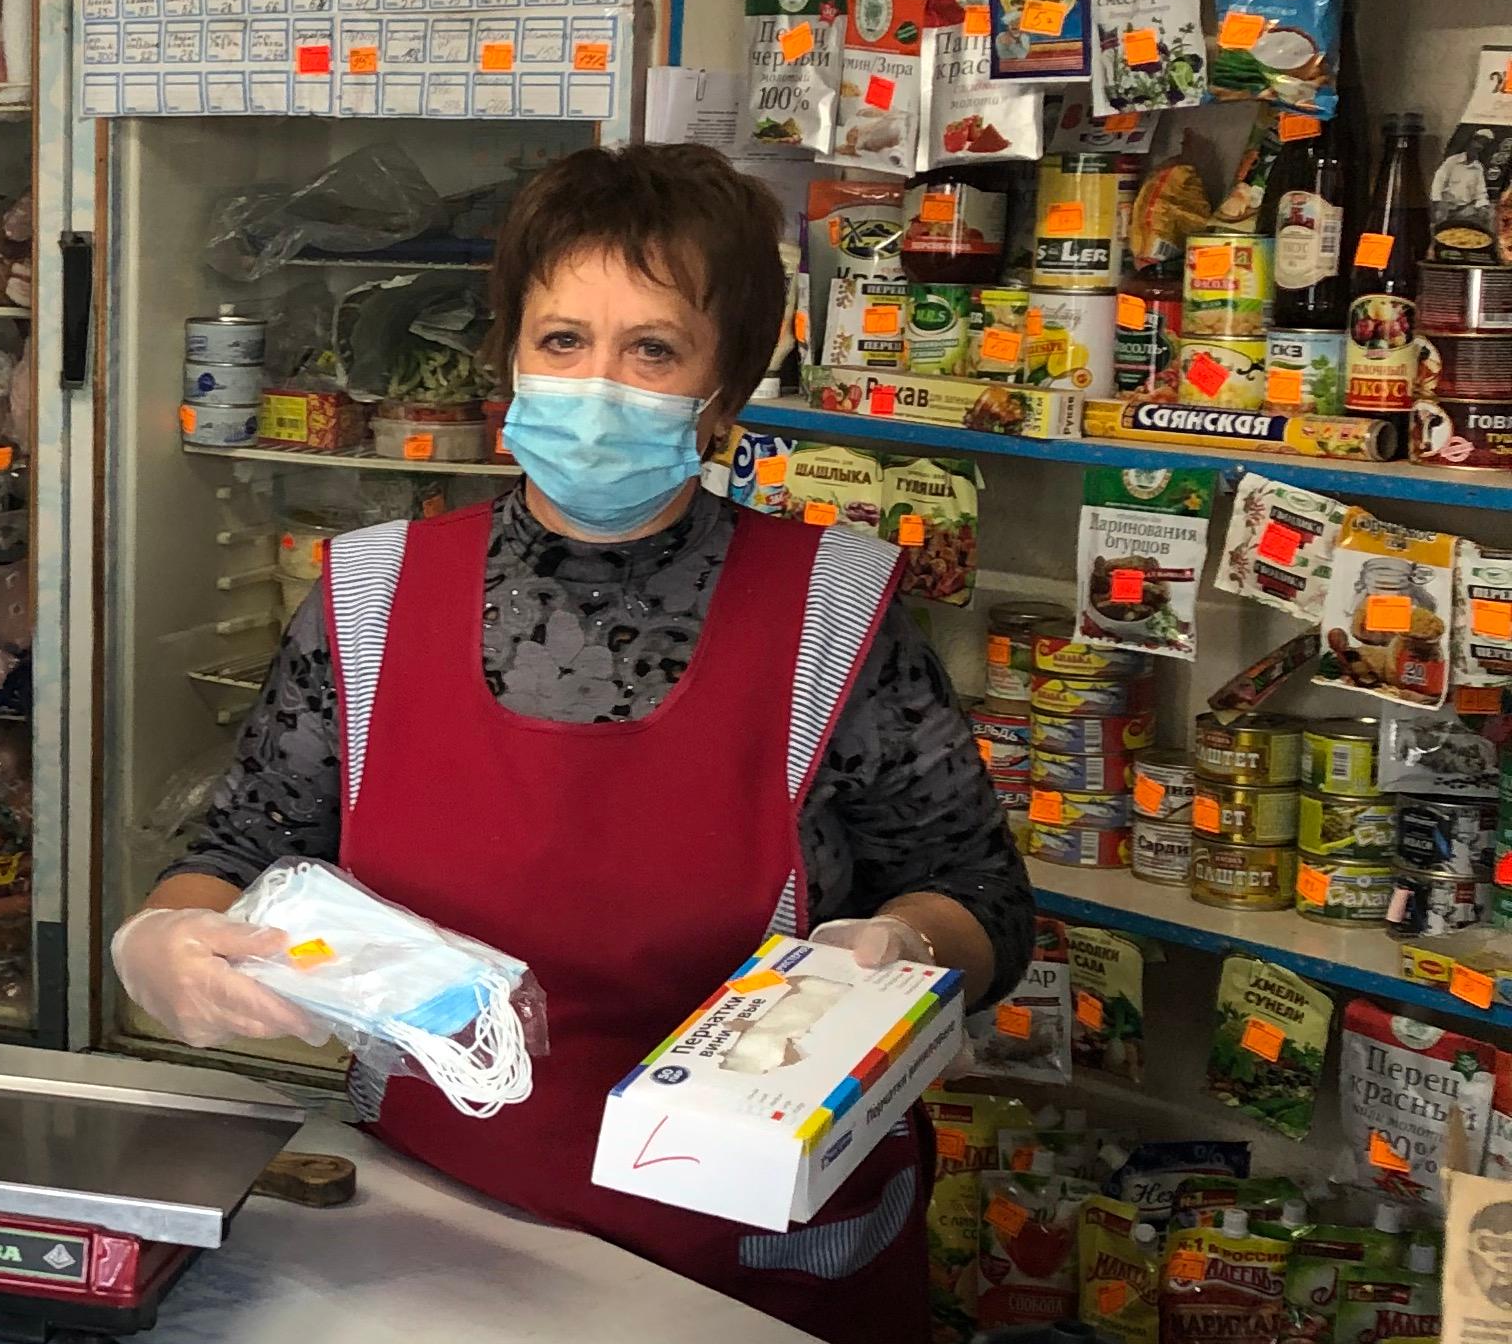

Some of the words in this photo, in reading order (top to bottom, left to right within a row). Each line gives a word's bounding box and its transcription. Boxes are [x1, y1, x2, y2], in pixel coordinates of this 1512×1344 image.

[759, 21, 827, 46] Пец
[841, 56, 914, 77] мин/Зира
[757, 86, 810, 110] 100%
[866, 378, 929, 407] Ркав
[794, 463, 872, 485] ШАШЛЫКА
[671, 995, 746, 1055] Перчатки
[1366, 1045, 1460, 1098] Перец
